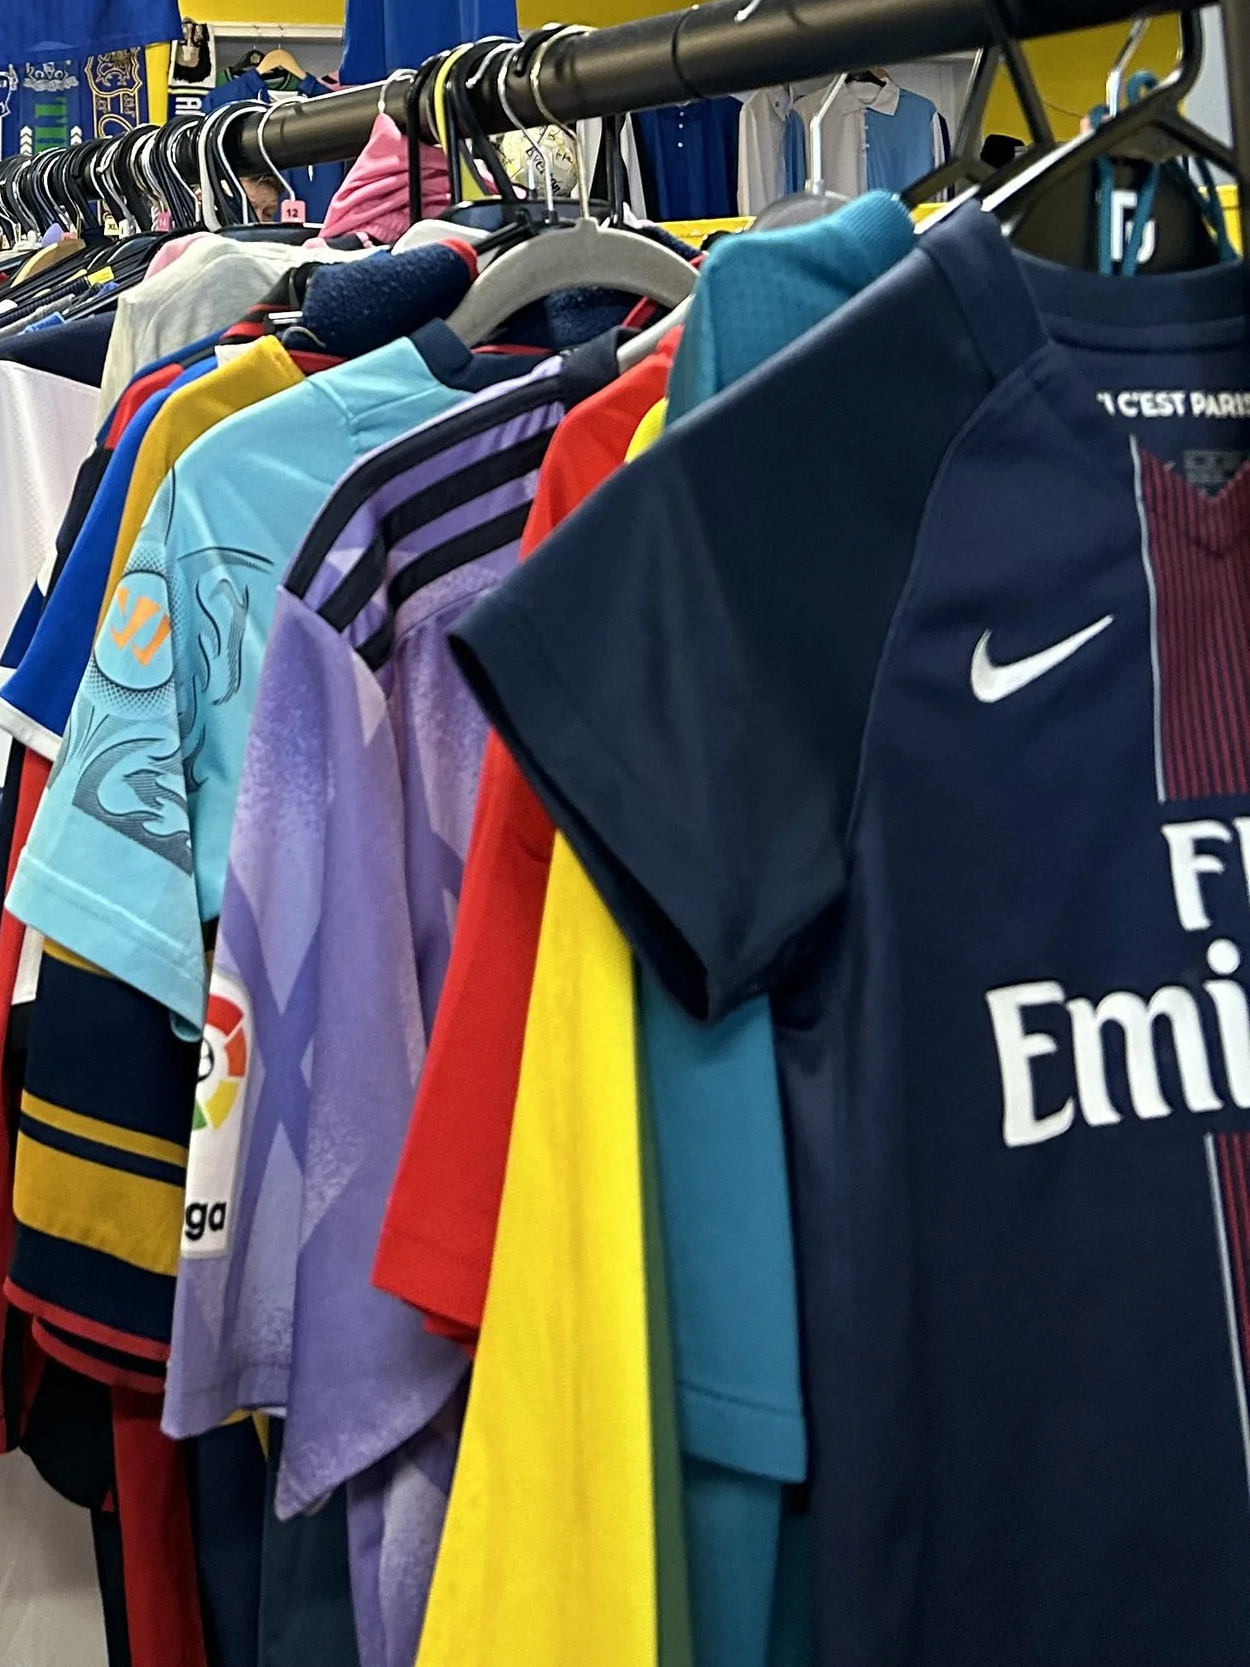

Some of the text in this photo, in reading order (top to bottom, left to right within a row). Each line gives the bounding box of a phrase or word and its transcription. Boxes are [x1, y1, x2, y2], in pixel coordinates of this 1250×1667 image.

[285, 209, 299, 218] 12
[108, 222, 118, 230] XL
[1117, 391, 1186, 419] C'EST
[184, 1200, 227, 1242] ga
